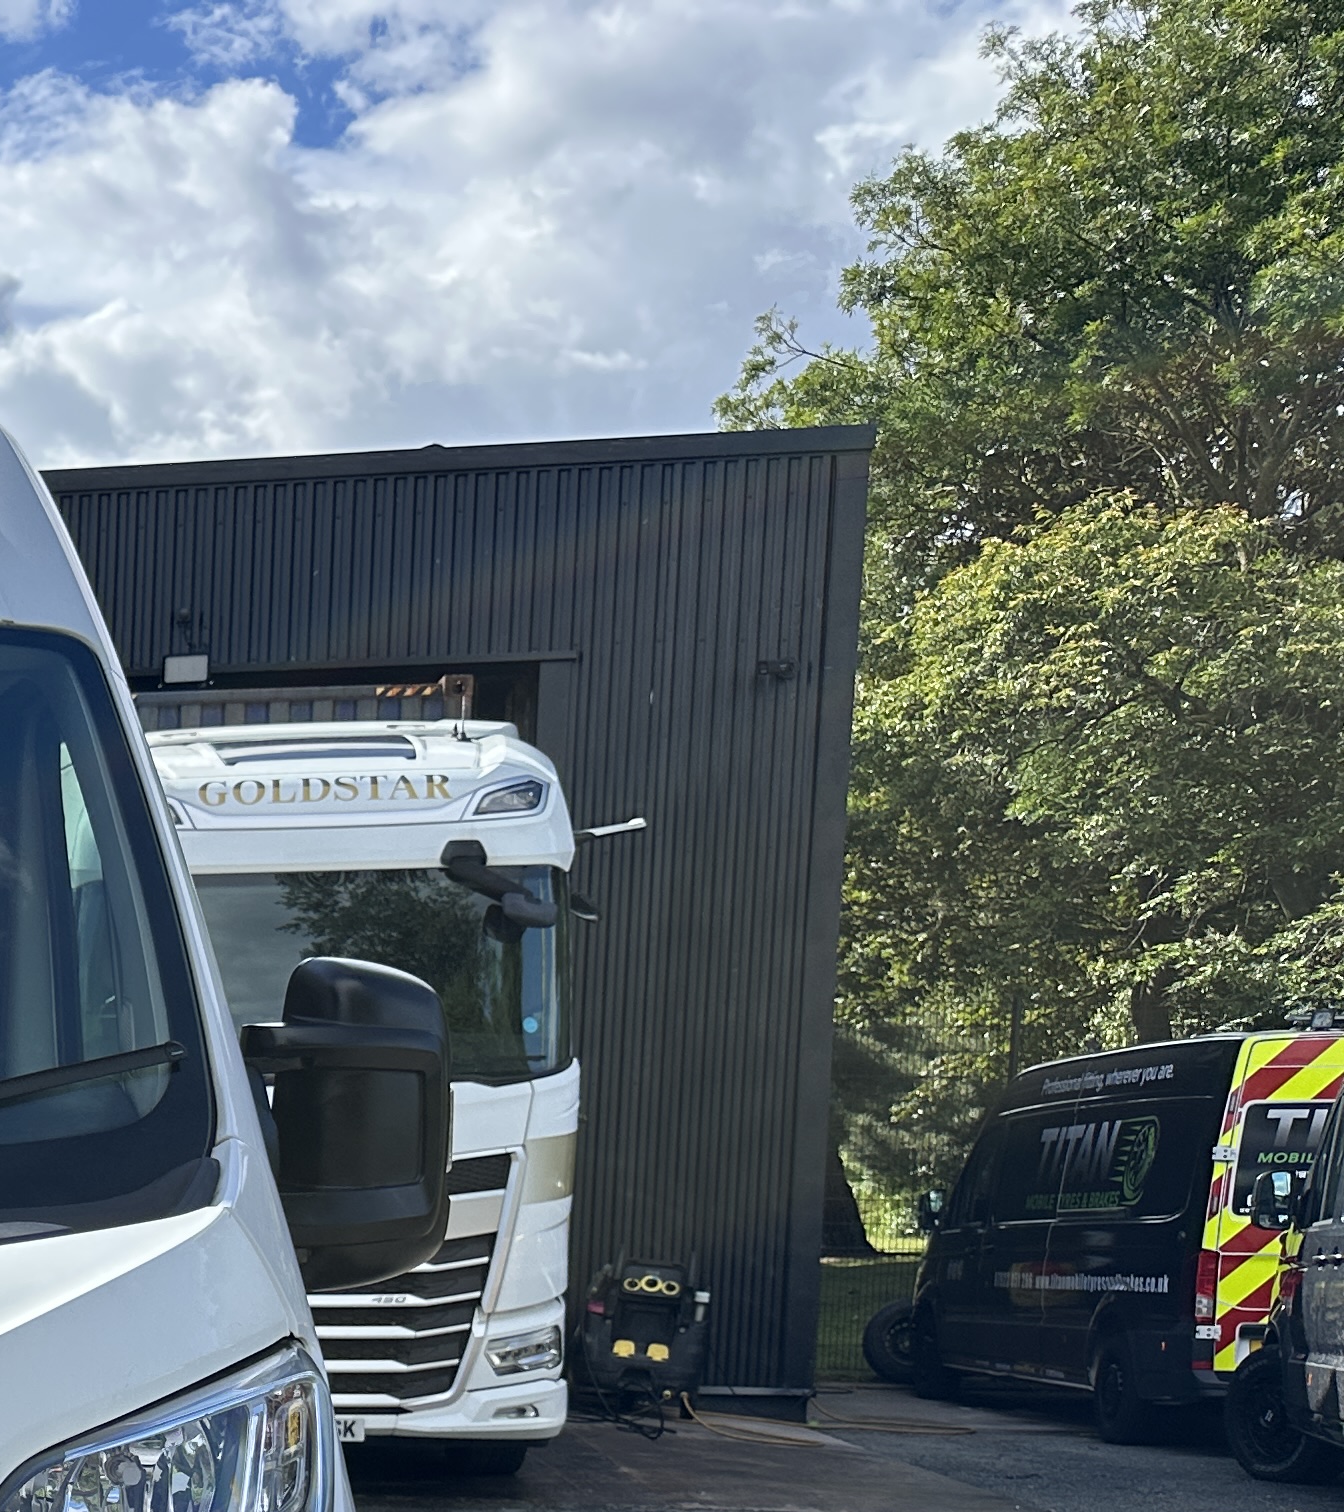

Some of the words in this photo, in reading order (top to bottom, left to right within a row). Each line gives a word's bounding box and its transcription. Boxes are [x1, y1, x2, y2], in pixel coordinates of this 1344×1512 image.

[198, 774, 453, 807] GOLDSTAR
[1105, 1067, 1141, 1086] wherever
[1139, 1065, 1158, 1086] you
[1039, 1120, 1122, 1182] TITAN
